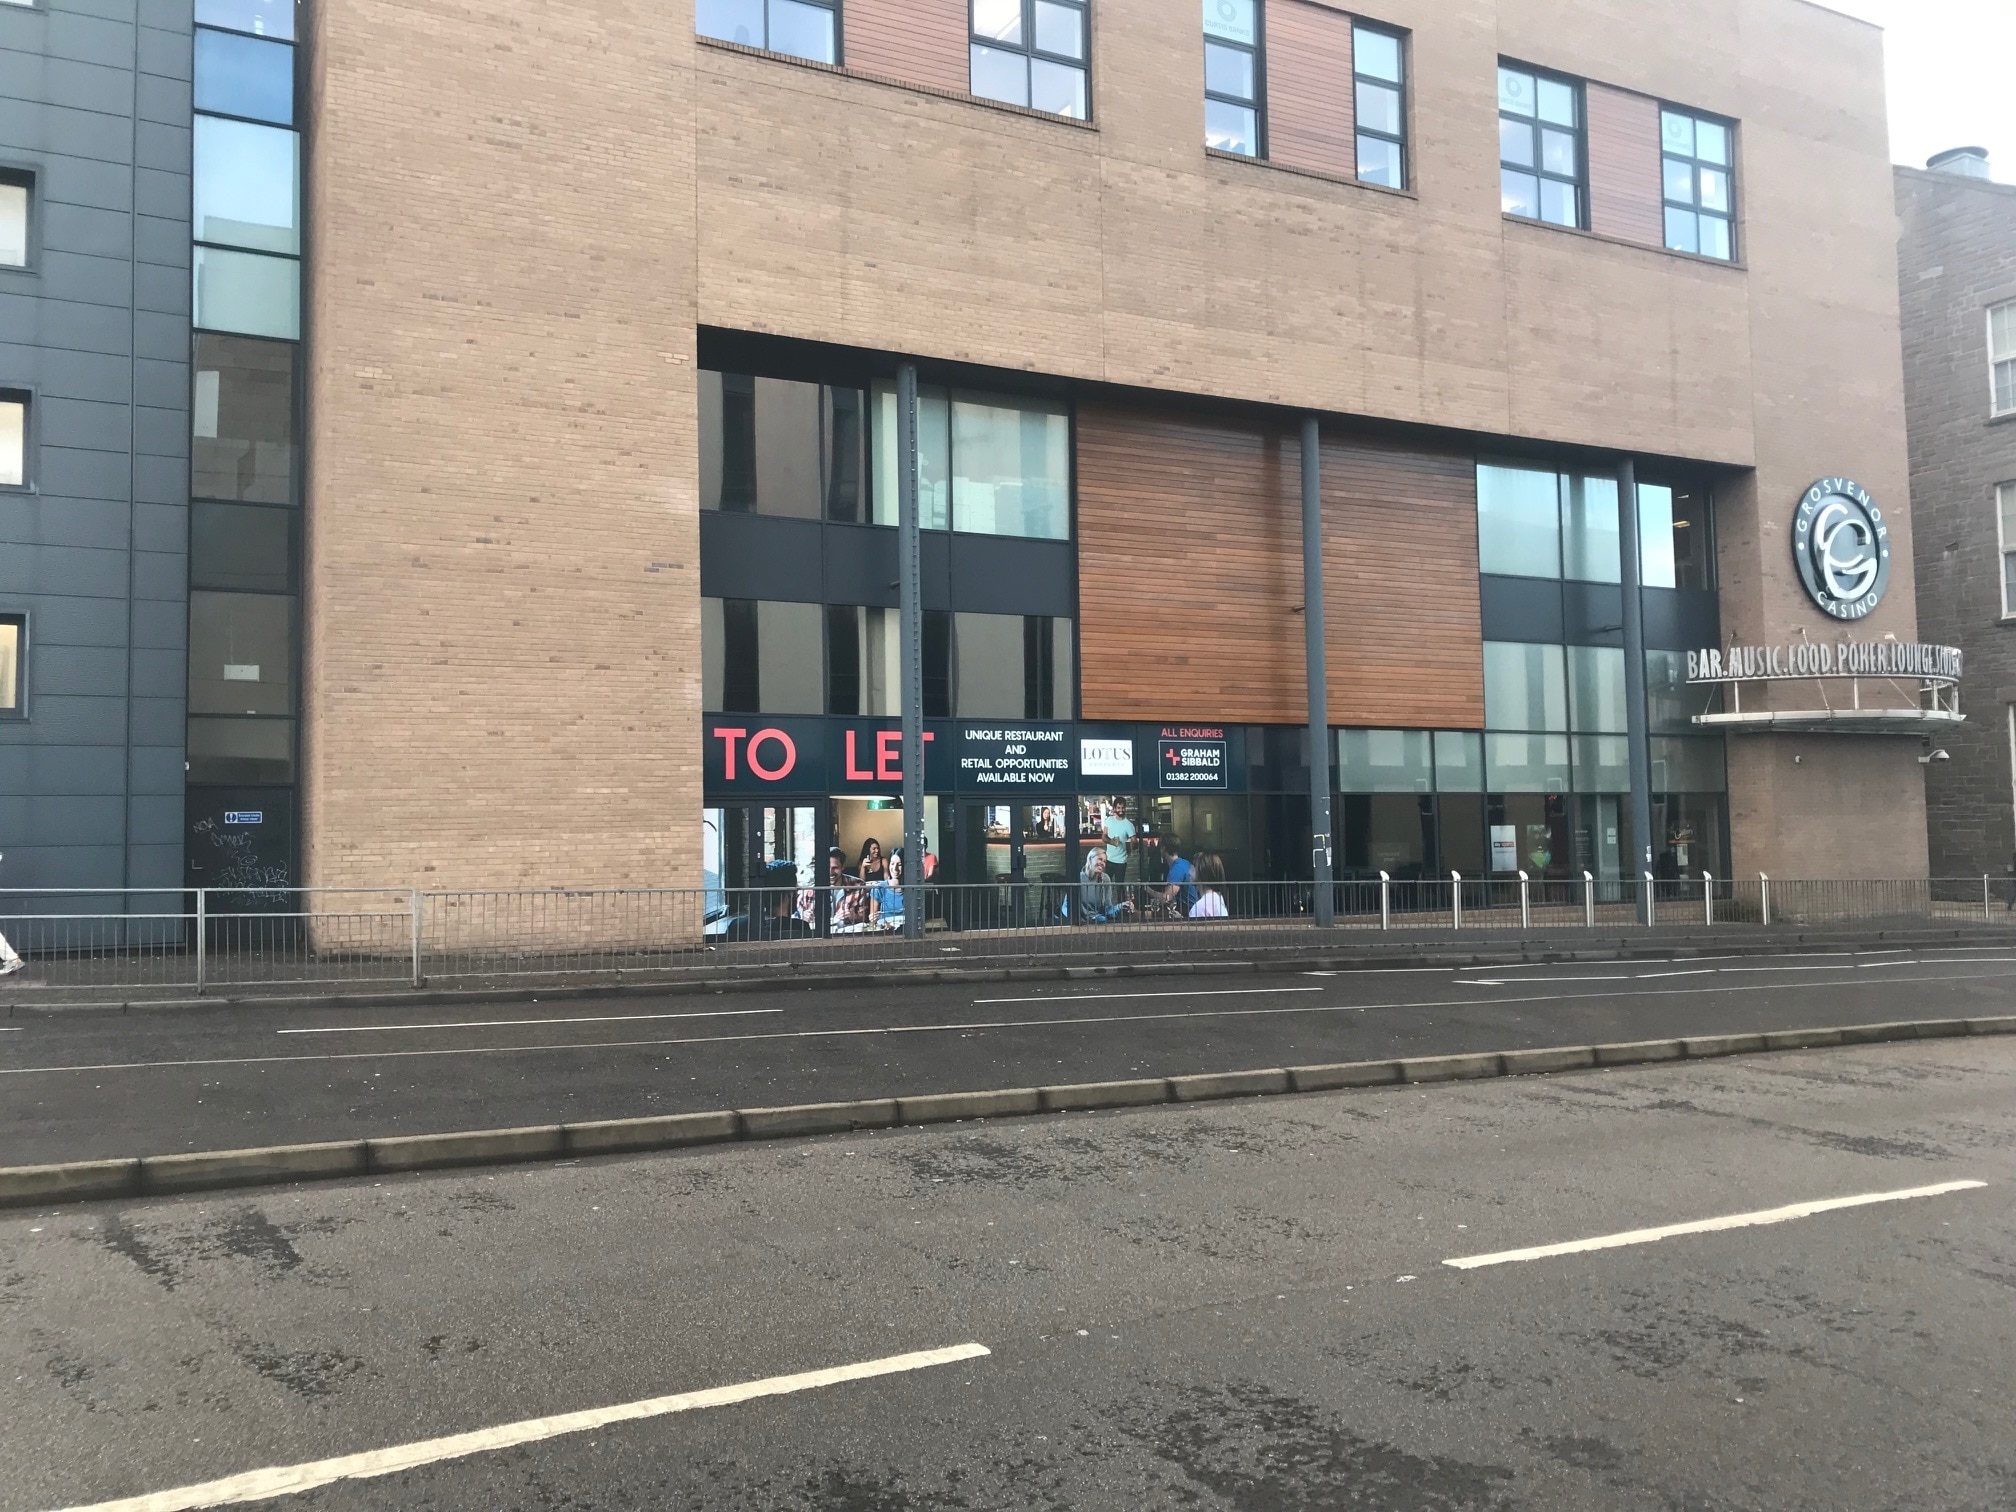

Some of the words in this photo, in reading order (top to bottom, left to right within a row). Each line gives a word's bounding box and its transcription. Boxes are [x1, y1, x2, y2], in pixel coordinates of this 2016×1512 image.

[1205, 20, 1228, 31] CURTIS
[1229, 25, 1250, 37] BANKS
[1797, 478, 1887, 539] GROSVENOR
[1817, 591, 1878, 618] CASINO
[965, 729, 1003, 741] UNIQUE
[1004, 730, 1064, 742] RESTAURANT
[1161, 727, 1178, 738] ALL
[1179, 728, 1224, 738] ENQUIRIES
[714, 728, 796, 781] TO
[1005, 744, 1027, 755] AND
[1083, 747, 1131, 760] LOTUS
[1180, 748, 1220, 758] GRAHAM
[961, 757, 993, 769] RETAIL
[995, 758, 1069, 770] OPPORTUNITIES
[1181, 757, 1220, 767] SIBBALD
[976, 772, 1027, 783] AVAILABLE
[1028, 772, 1055, 783] NOW
[1166, 772, 1189, 781] 01382
[1189, 773, 1219, 781] 200064
